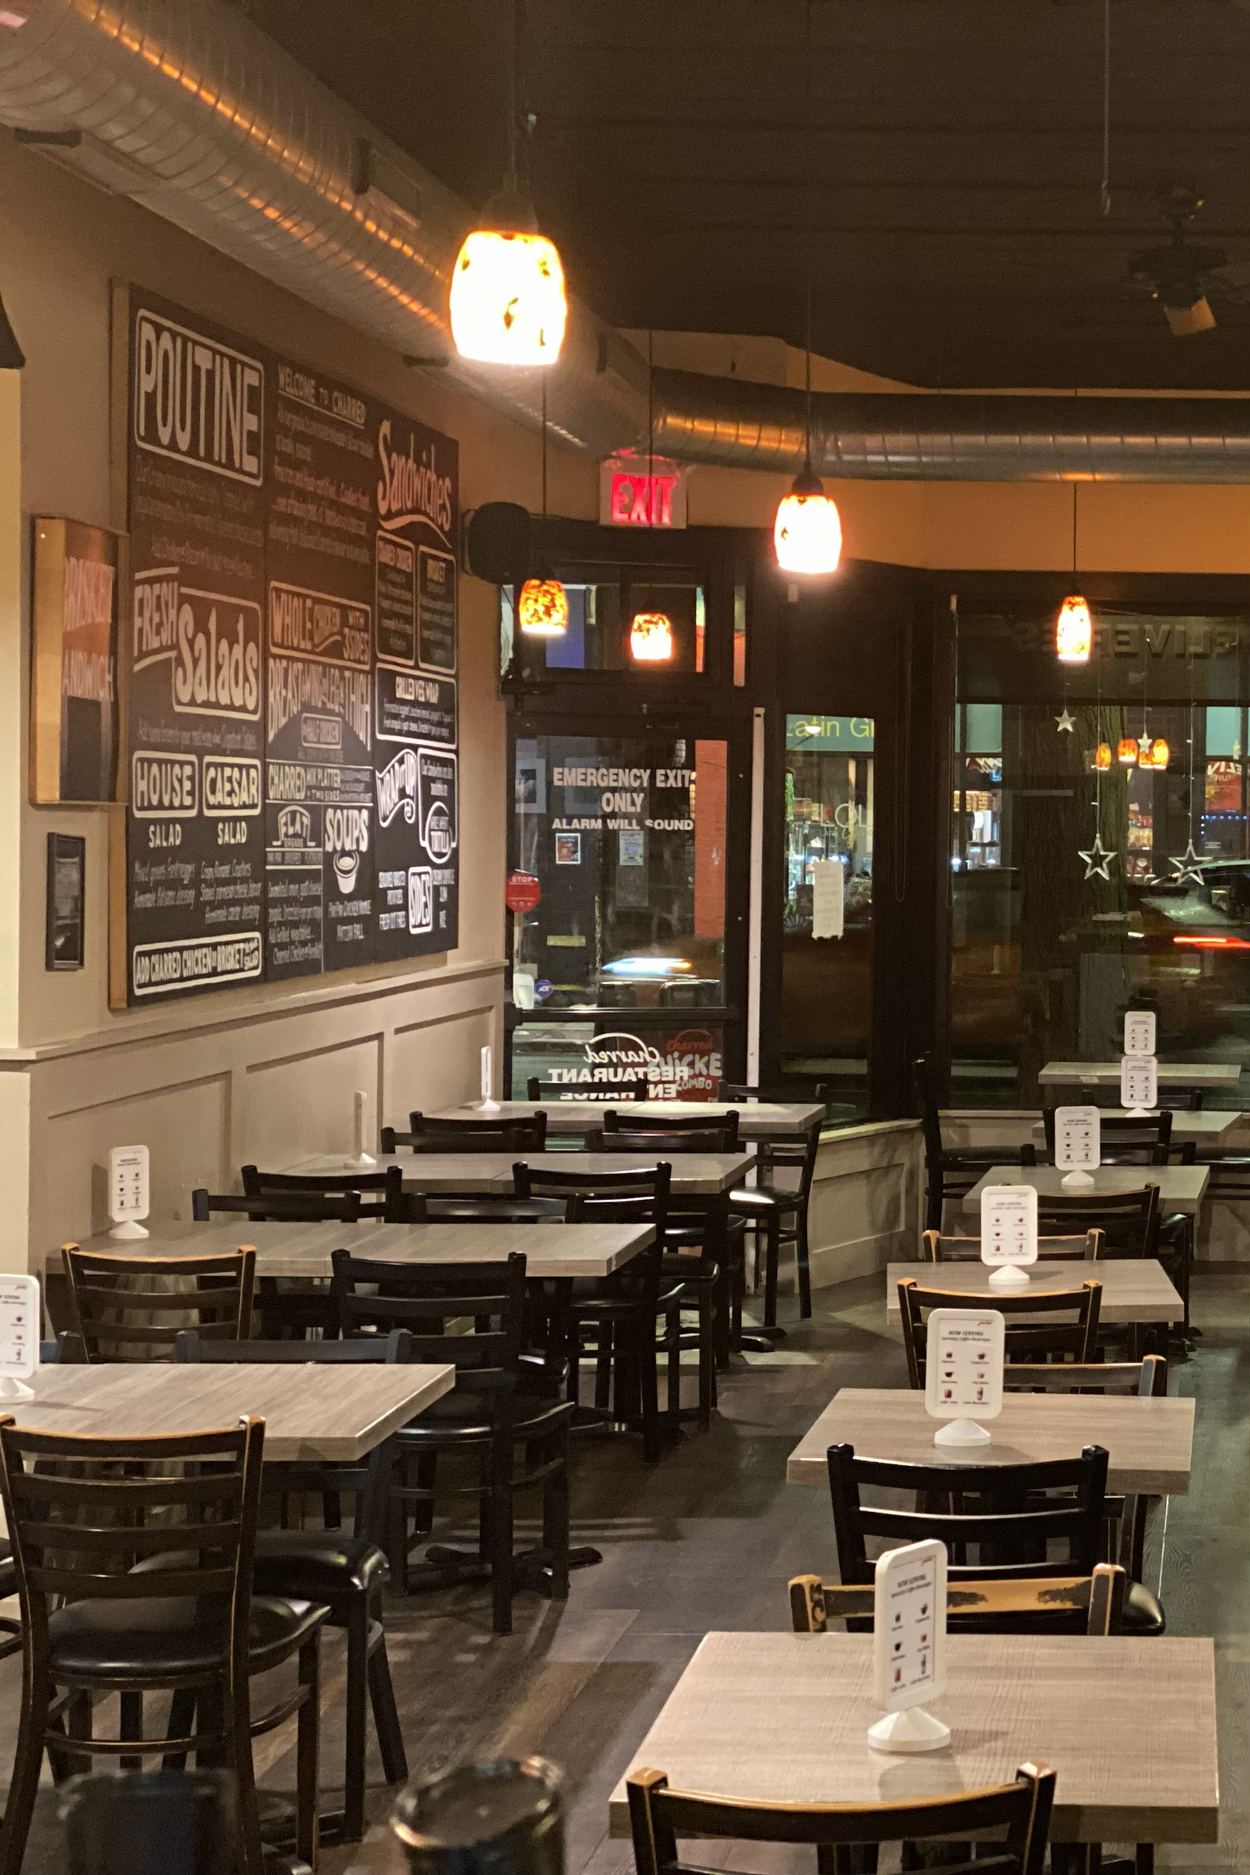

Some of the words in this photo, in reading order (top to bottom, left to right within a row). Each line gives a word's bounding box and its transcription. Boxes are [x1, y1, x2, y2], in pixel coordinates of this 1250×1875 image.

[140, 321, 259, 474] POUTINE
[278, 363, 316, 405] WELCOME
[332, 390, 366, 425] CHARRED
[378, 419, 452, 532] Sandwiches
[612, 474, 676, 525] EXIT
[134, 581, 178, 657] FRESH
[272, 590, 312, 650] WHOLE
[176, 602, 258, 711] Salads
[268, 658, 303, 744] BREAST
[344, 670, 371, 752] THIGH
[787, 716, 840, 737] atin
[137, 761, 192, 808] HOUSE
[206, 766, 258, 808] CAESAR
[269, 764, 306, 800] CHARRED
[553, 767, 651, 787] EMERGENCY
[656, 769, 691, 788] EXIT
[552, 818, 602, 829] ALARM
[606, 819, 640, 830] WILL
[645, 819, 694, 830] SOUND
[602, 792, 644, 812] ONLY
[149, 823, 182, 848] SALAD
[217, 821, 247, 845] SALAD
[280, 811, 308, 841] FLAT
[325, 808, 369, 853] SOUPS
[410, 874, 431, 926] SIDES
[136, 956, 150, 983] ADD
[151, 951, 181, 982] CHARRED
[182, 946, 212, 977] CHICKEN
[217, 942, 244, 972] BRISKET
